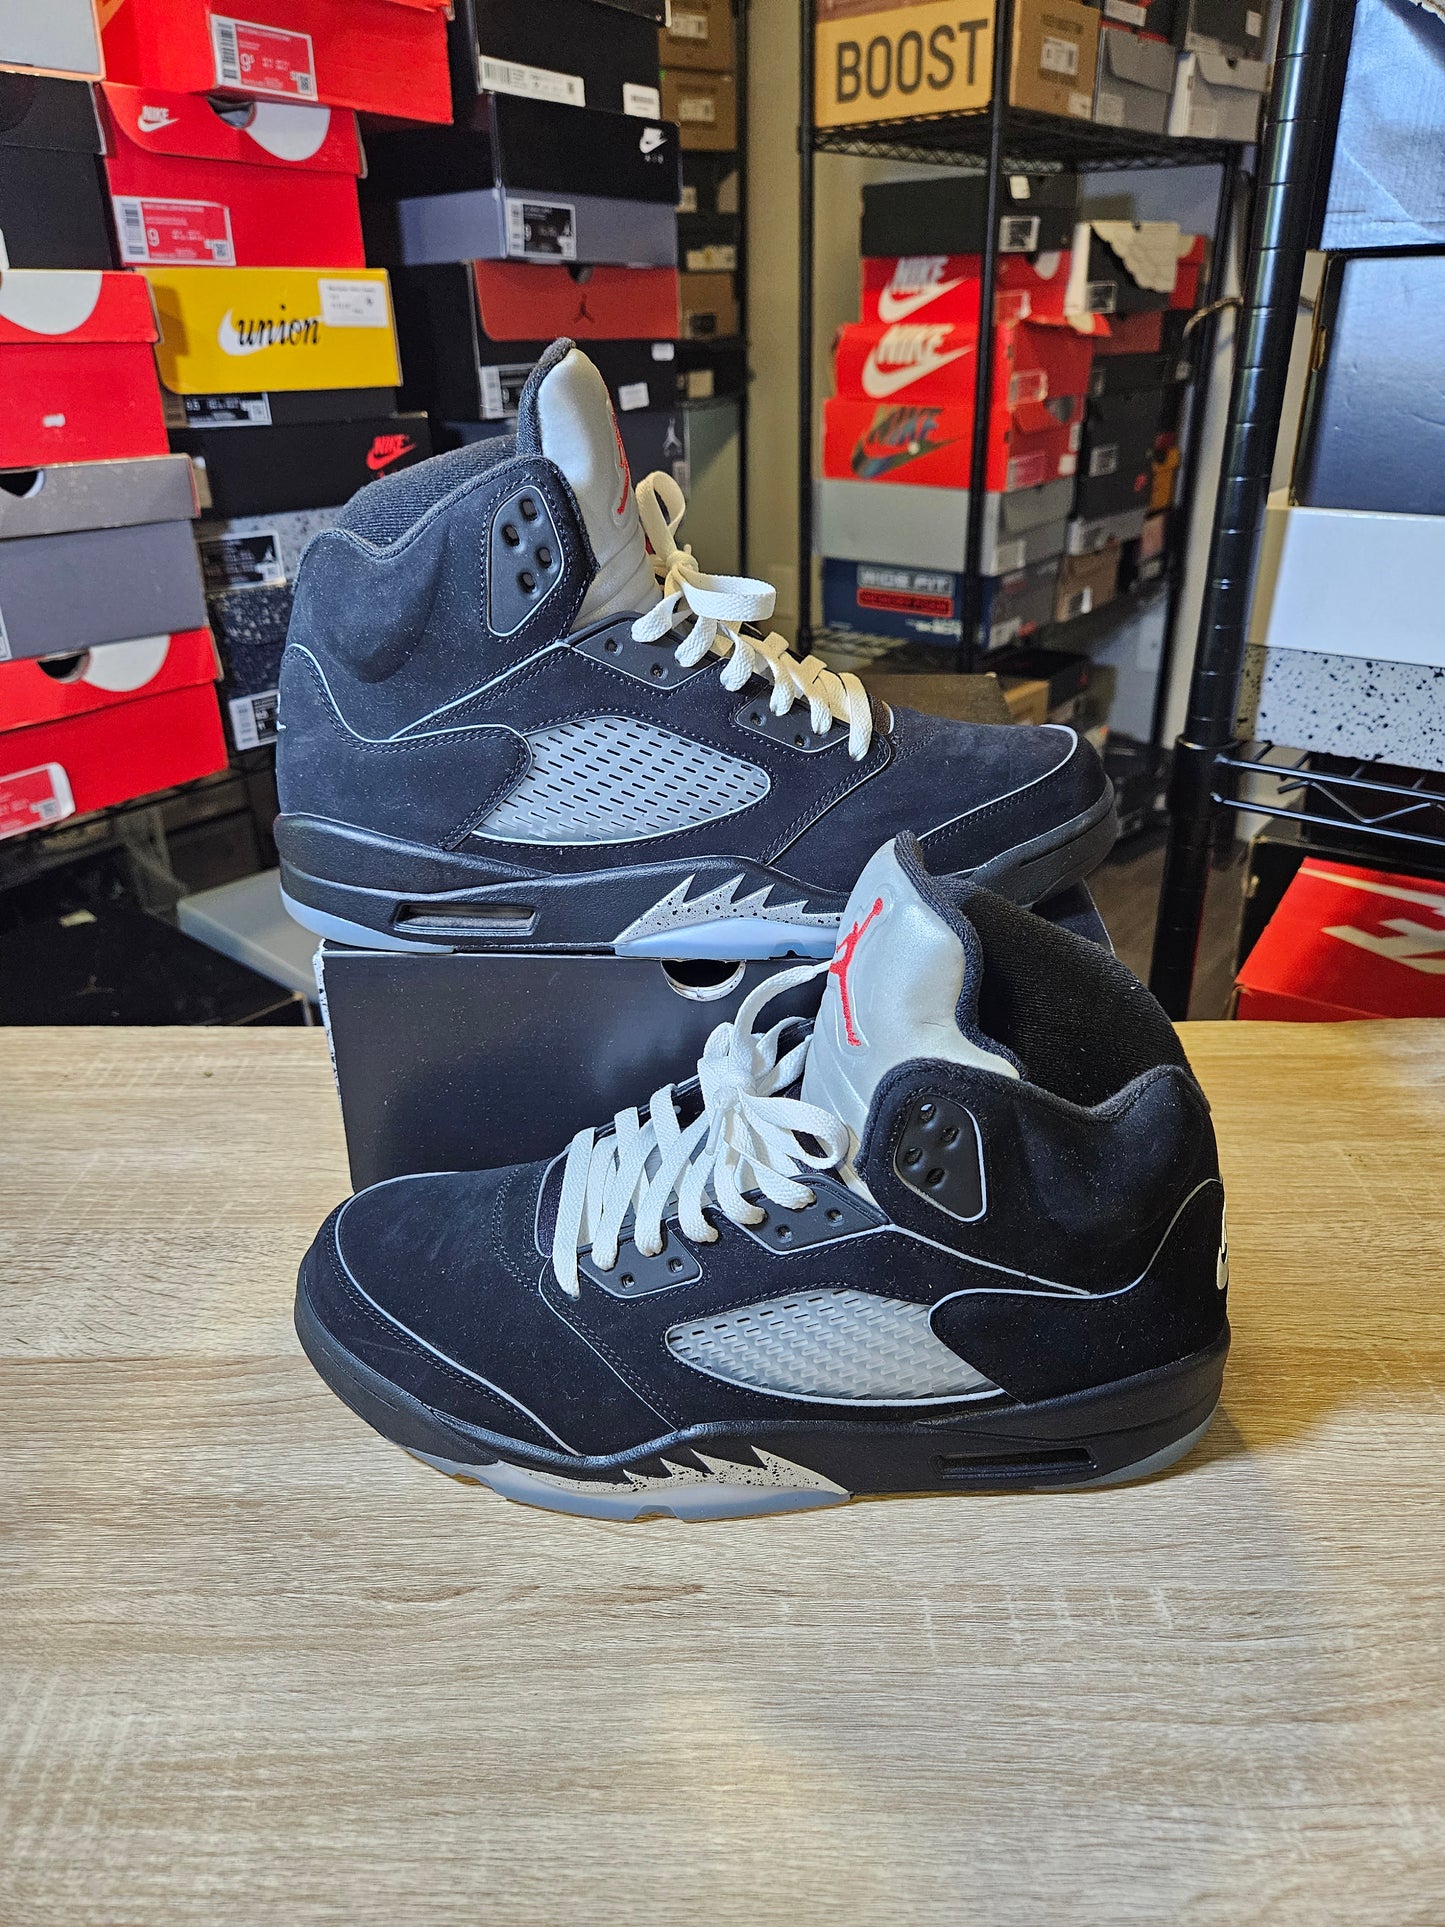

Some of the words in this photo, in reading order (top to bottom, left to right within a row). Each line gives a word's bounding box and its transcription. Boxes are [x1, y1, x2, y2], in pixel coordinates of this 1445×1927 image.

[836, 18, 988, 104] BOOST
[142, 105, 169, 120] NIKE
[147, 228, 160, 247] 9
[890, 256, 948, 290] NIKE
[237, 303, 321, 346] union
[876, 324, 955, 364] NIKE
[867, 405, 943, 445] NIKE
[373, 433, 409, 455] NIKE
